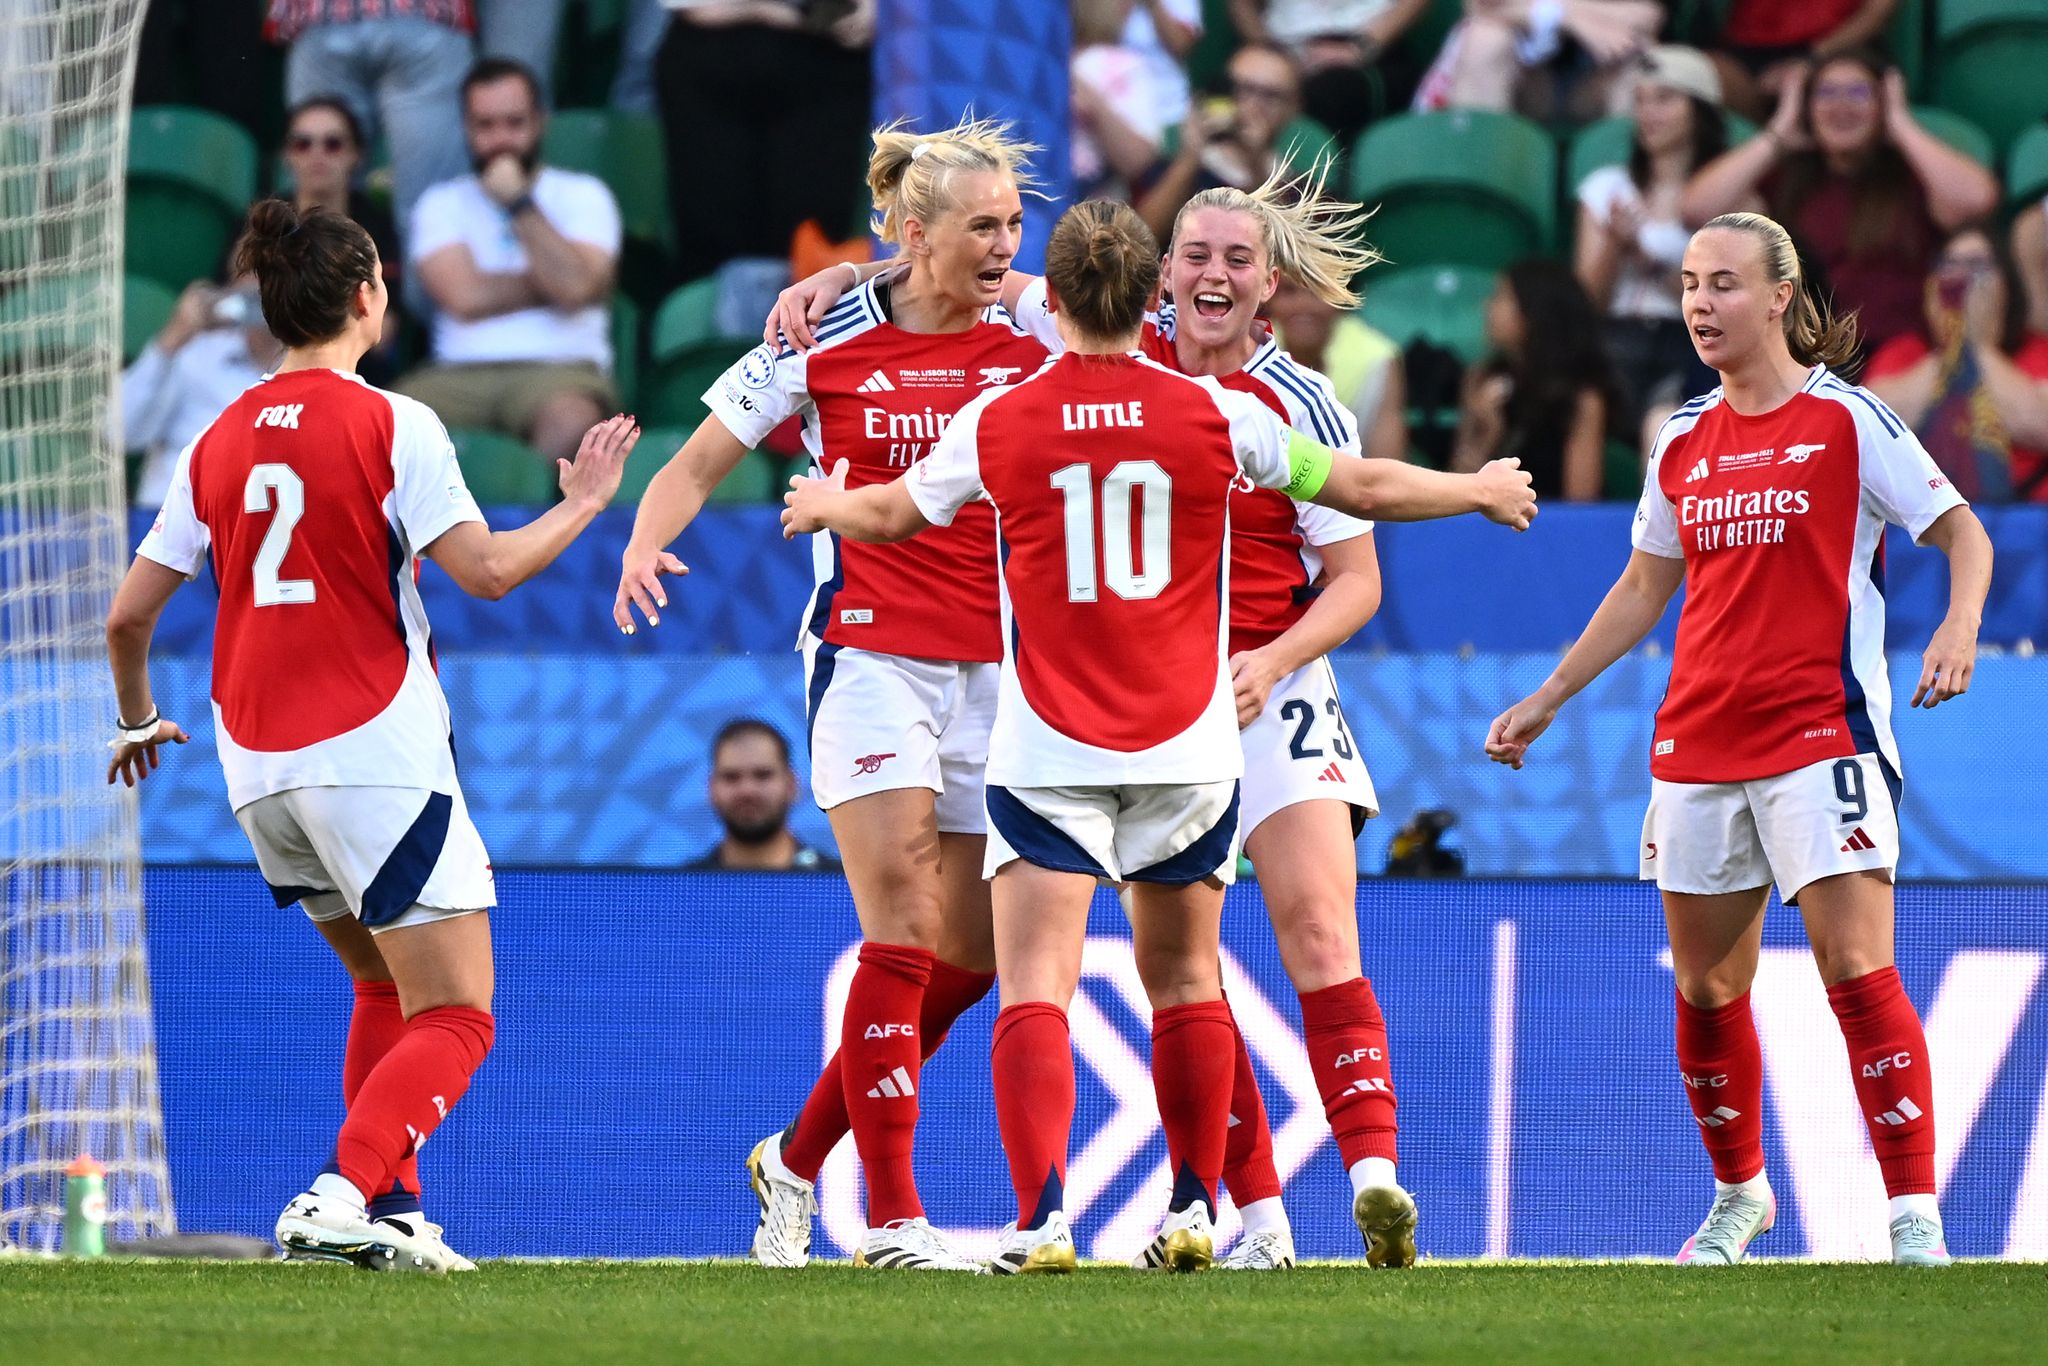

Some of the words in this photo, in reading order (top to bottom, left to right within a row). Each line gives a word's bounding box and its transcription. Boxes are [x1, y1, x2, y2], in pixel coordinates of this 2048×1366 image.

[899, 369, 920, 377] FINAL
[921, 369, 948, 377] LISBON
[948, 369, 966, 377] 2025
[254, 403, 304, 430] FOX
[863, 406, 953, 439] Emir
[1062, 400, 1144, 431] LITTLE
[888, 443, 921, 467] FLY
[1681, 486, 1811, 526] Emirates
[244, 463, 316, 607] 2
[1050, 459, 1172, 603] 10
[1696, 524, 1721, 552] FLY
[1726, 518, 1786, 548] BETTER
[1280, 697, 1353, 761] 23
[1832, 758, 1869, 824] 9
[864, 1023, 915, 1040] AFC
[1334, 1047, 1382, 1069] AFC
[1862, 1051, 1912, 1078] AFC
[1681, 1071, 1729, 1089] AFC
